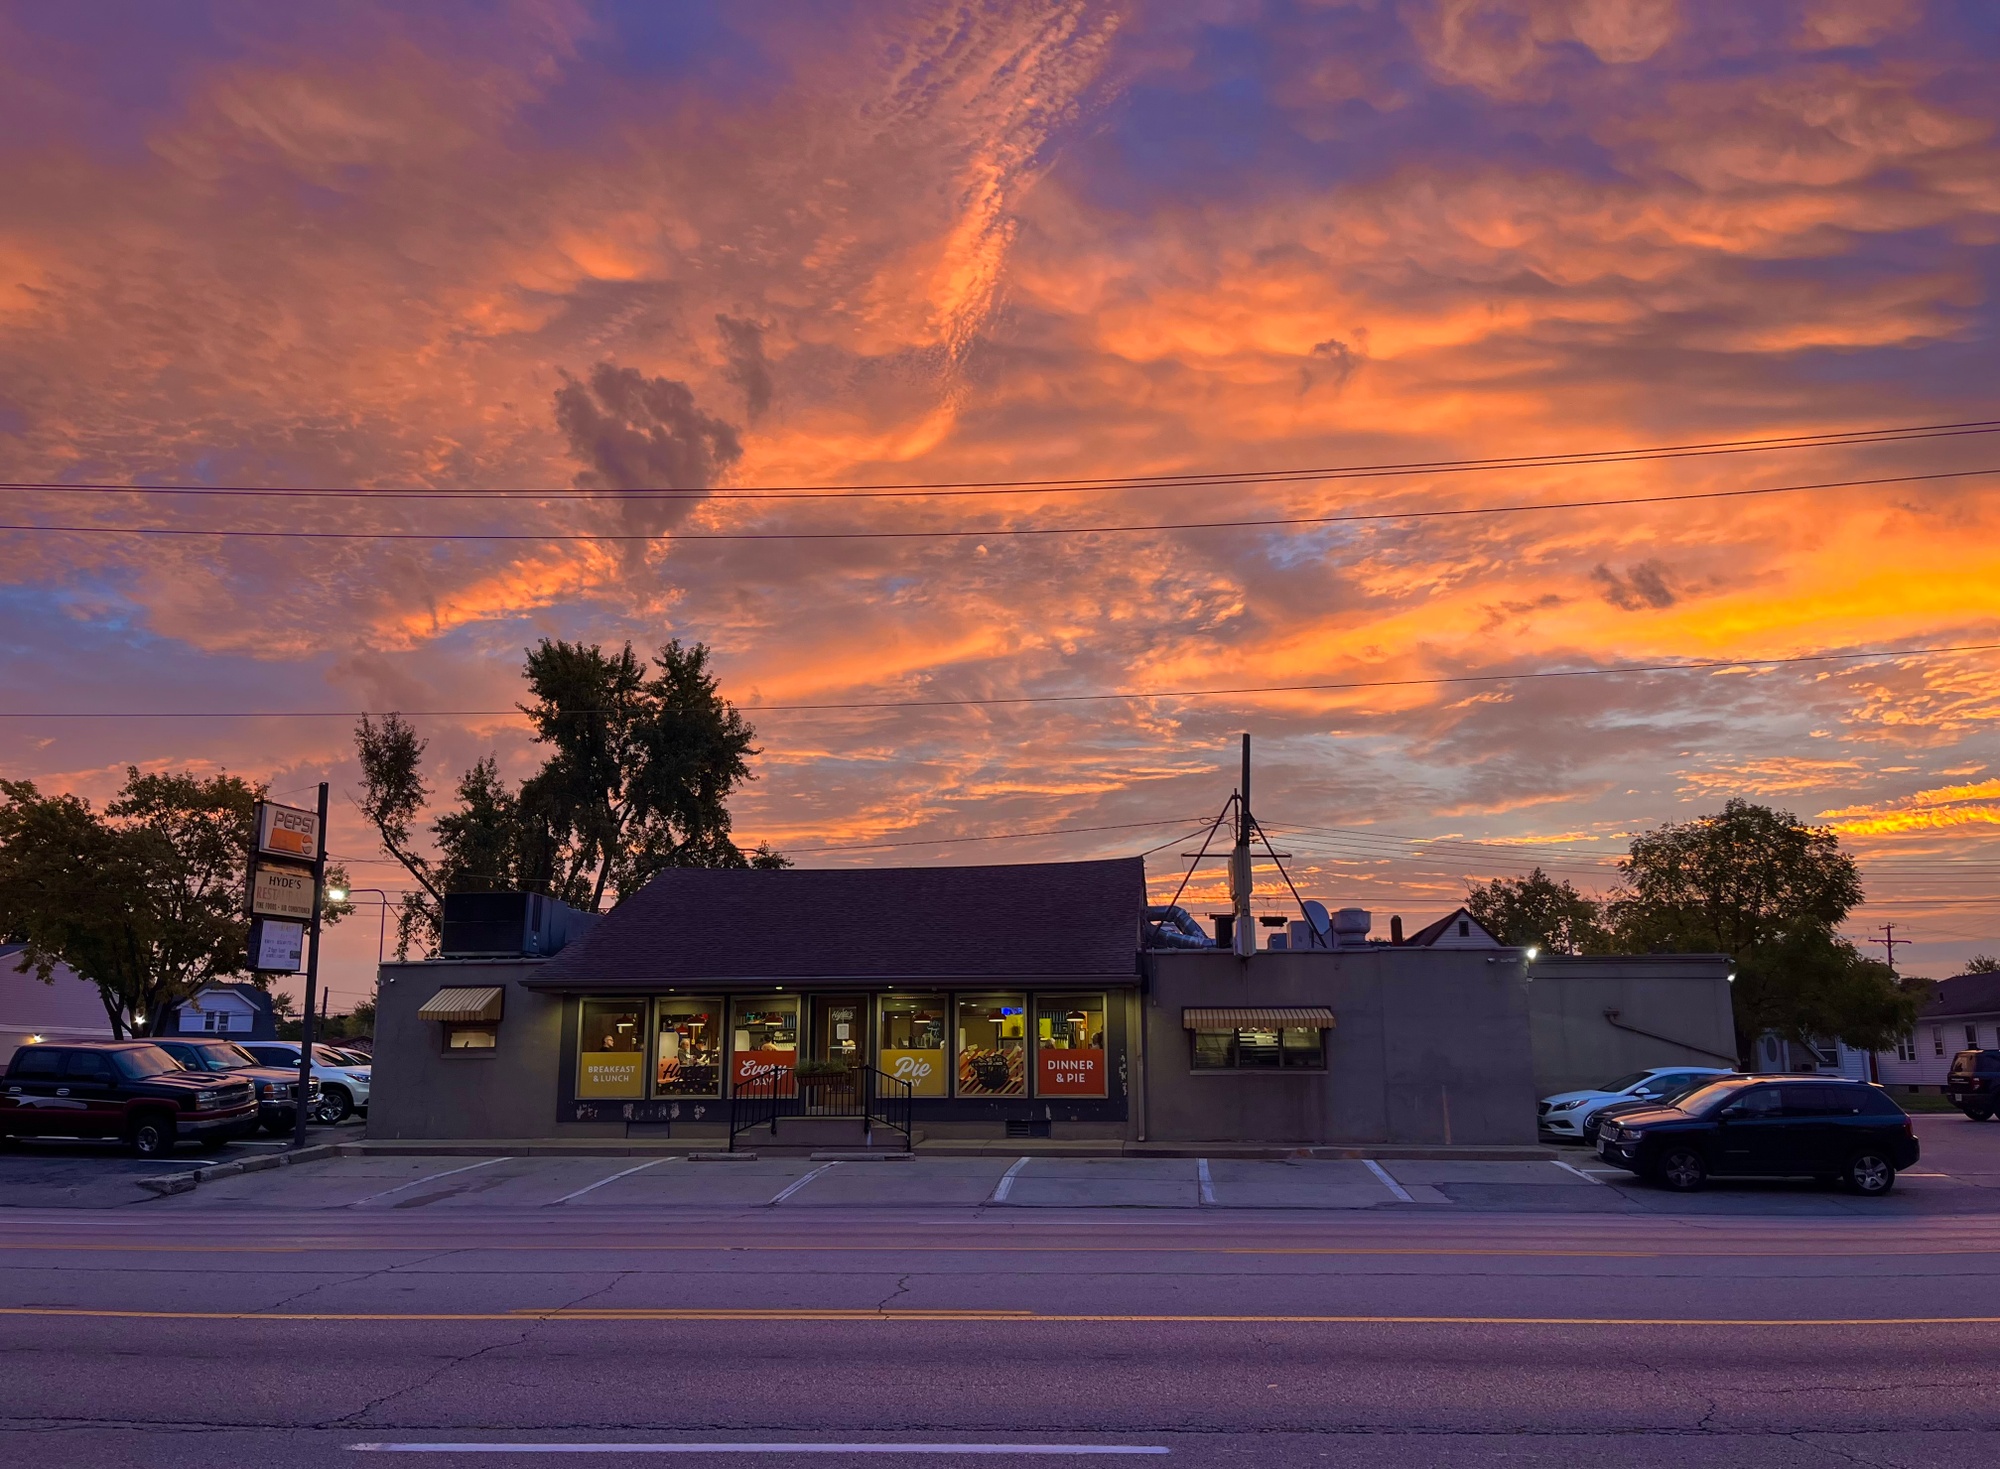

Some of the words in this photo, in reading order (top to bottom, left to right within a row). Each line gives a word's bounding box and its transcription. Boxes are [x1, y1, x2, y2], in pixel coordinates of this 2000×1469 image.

[273, 810, 315, 835] PEPSI
[268, 875, 302, 890] HYDE'S
[256, 885, 311, 905] RESTAUR
[588, 1065, 636, 1073] BREAKFAST
[893, 1056, 932, 1078] Pie
[1047, 1060, 1094, 1070] DINNER
[1056, 1073, 1064, 1083] &
[1067, 1073, 1086, 1083] PIE
